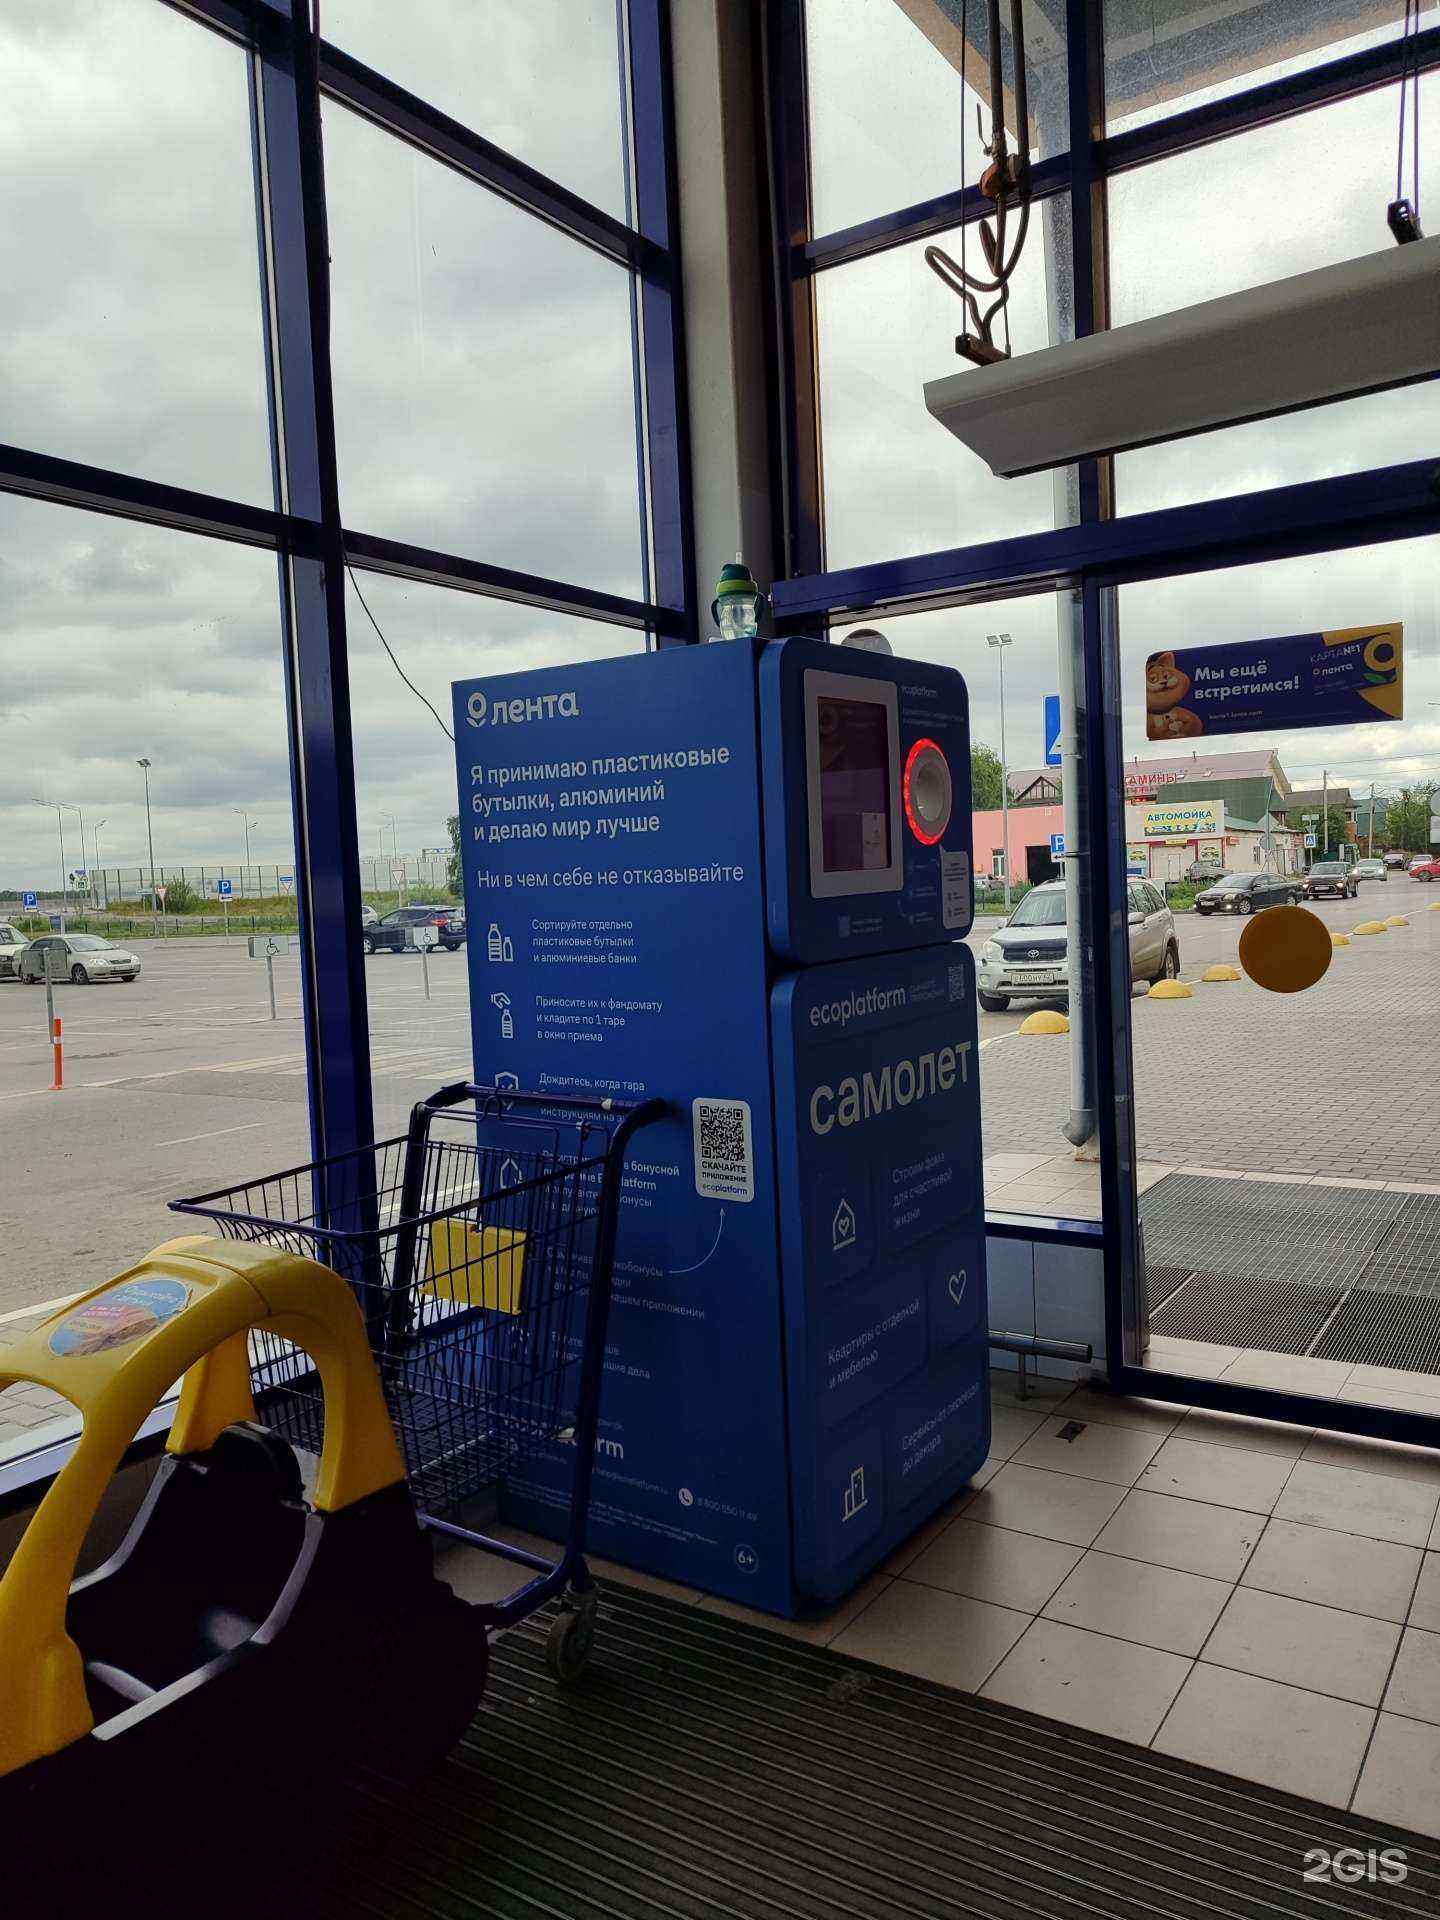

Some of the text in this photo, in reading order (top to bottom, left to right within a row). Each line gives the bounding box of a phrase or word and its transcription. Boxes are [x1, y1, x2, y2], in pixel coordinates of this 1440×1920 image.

[1195, 660, 1268, 681] Мы ещё
[1194, 675, 1300, 700] встретимся!
[491, 691, 580, 725] лента
[470, 746, 730, 787] Я принимаю пластиковые
[472, 779, 665, 818] бутылки, алюминий
[1148, 809, 1213, 822] АВТОМОЙКА
[473, 814, 660, 843] и делаю мир лучше
[478, 863, 744, 888] Ни в чем себе не отказывайте
[531, 918, 633, 933] Сортируйте отдельно
[532, 936, 634, 948] пластиковые бутылки
[533, 952, 637, 964] и алюминиевые банки
[535, 995, 586, 1009] Приносите
[588, 999, 599, 1009] их
[608, 997, 663, 1012] фандомату
[810, 986, 906, 1027] ecoplatform
[536, 1014, 626, 1028] и кладите по 1 таре
[537, 1030, 603, 1043] в окно приема
[539, 1072, 646, 1092] Дождитесь, когда тара
[810, 1041, 971, 1136] самолет
[631, 1160, 680, 1177] бонусной
[702, 1161, 747, 1174] СКАЧАЙТЕ
[738, 1551, 754, 1564] 6+
